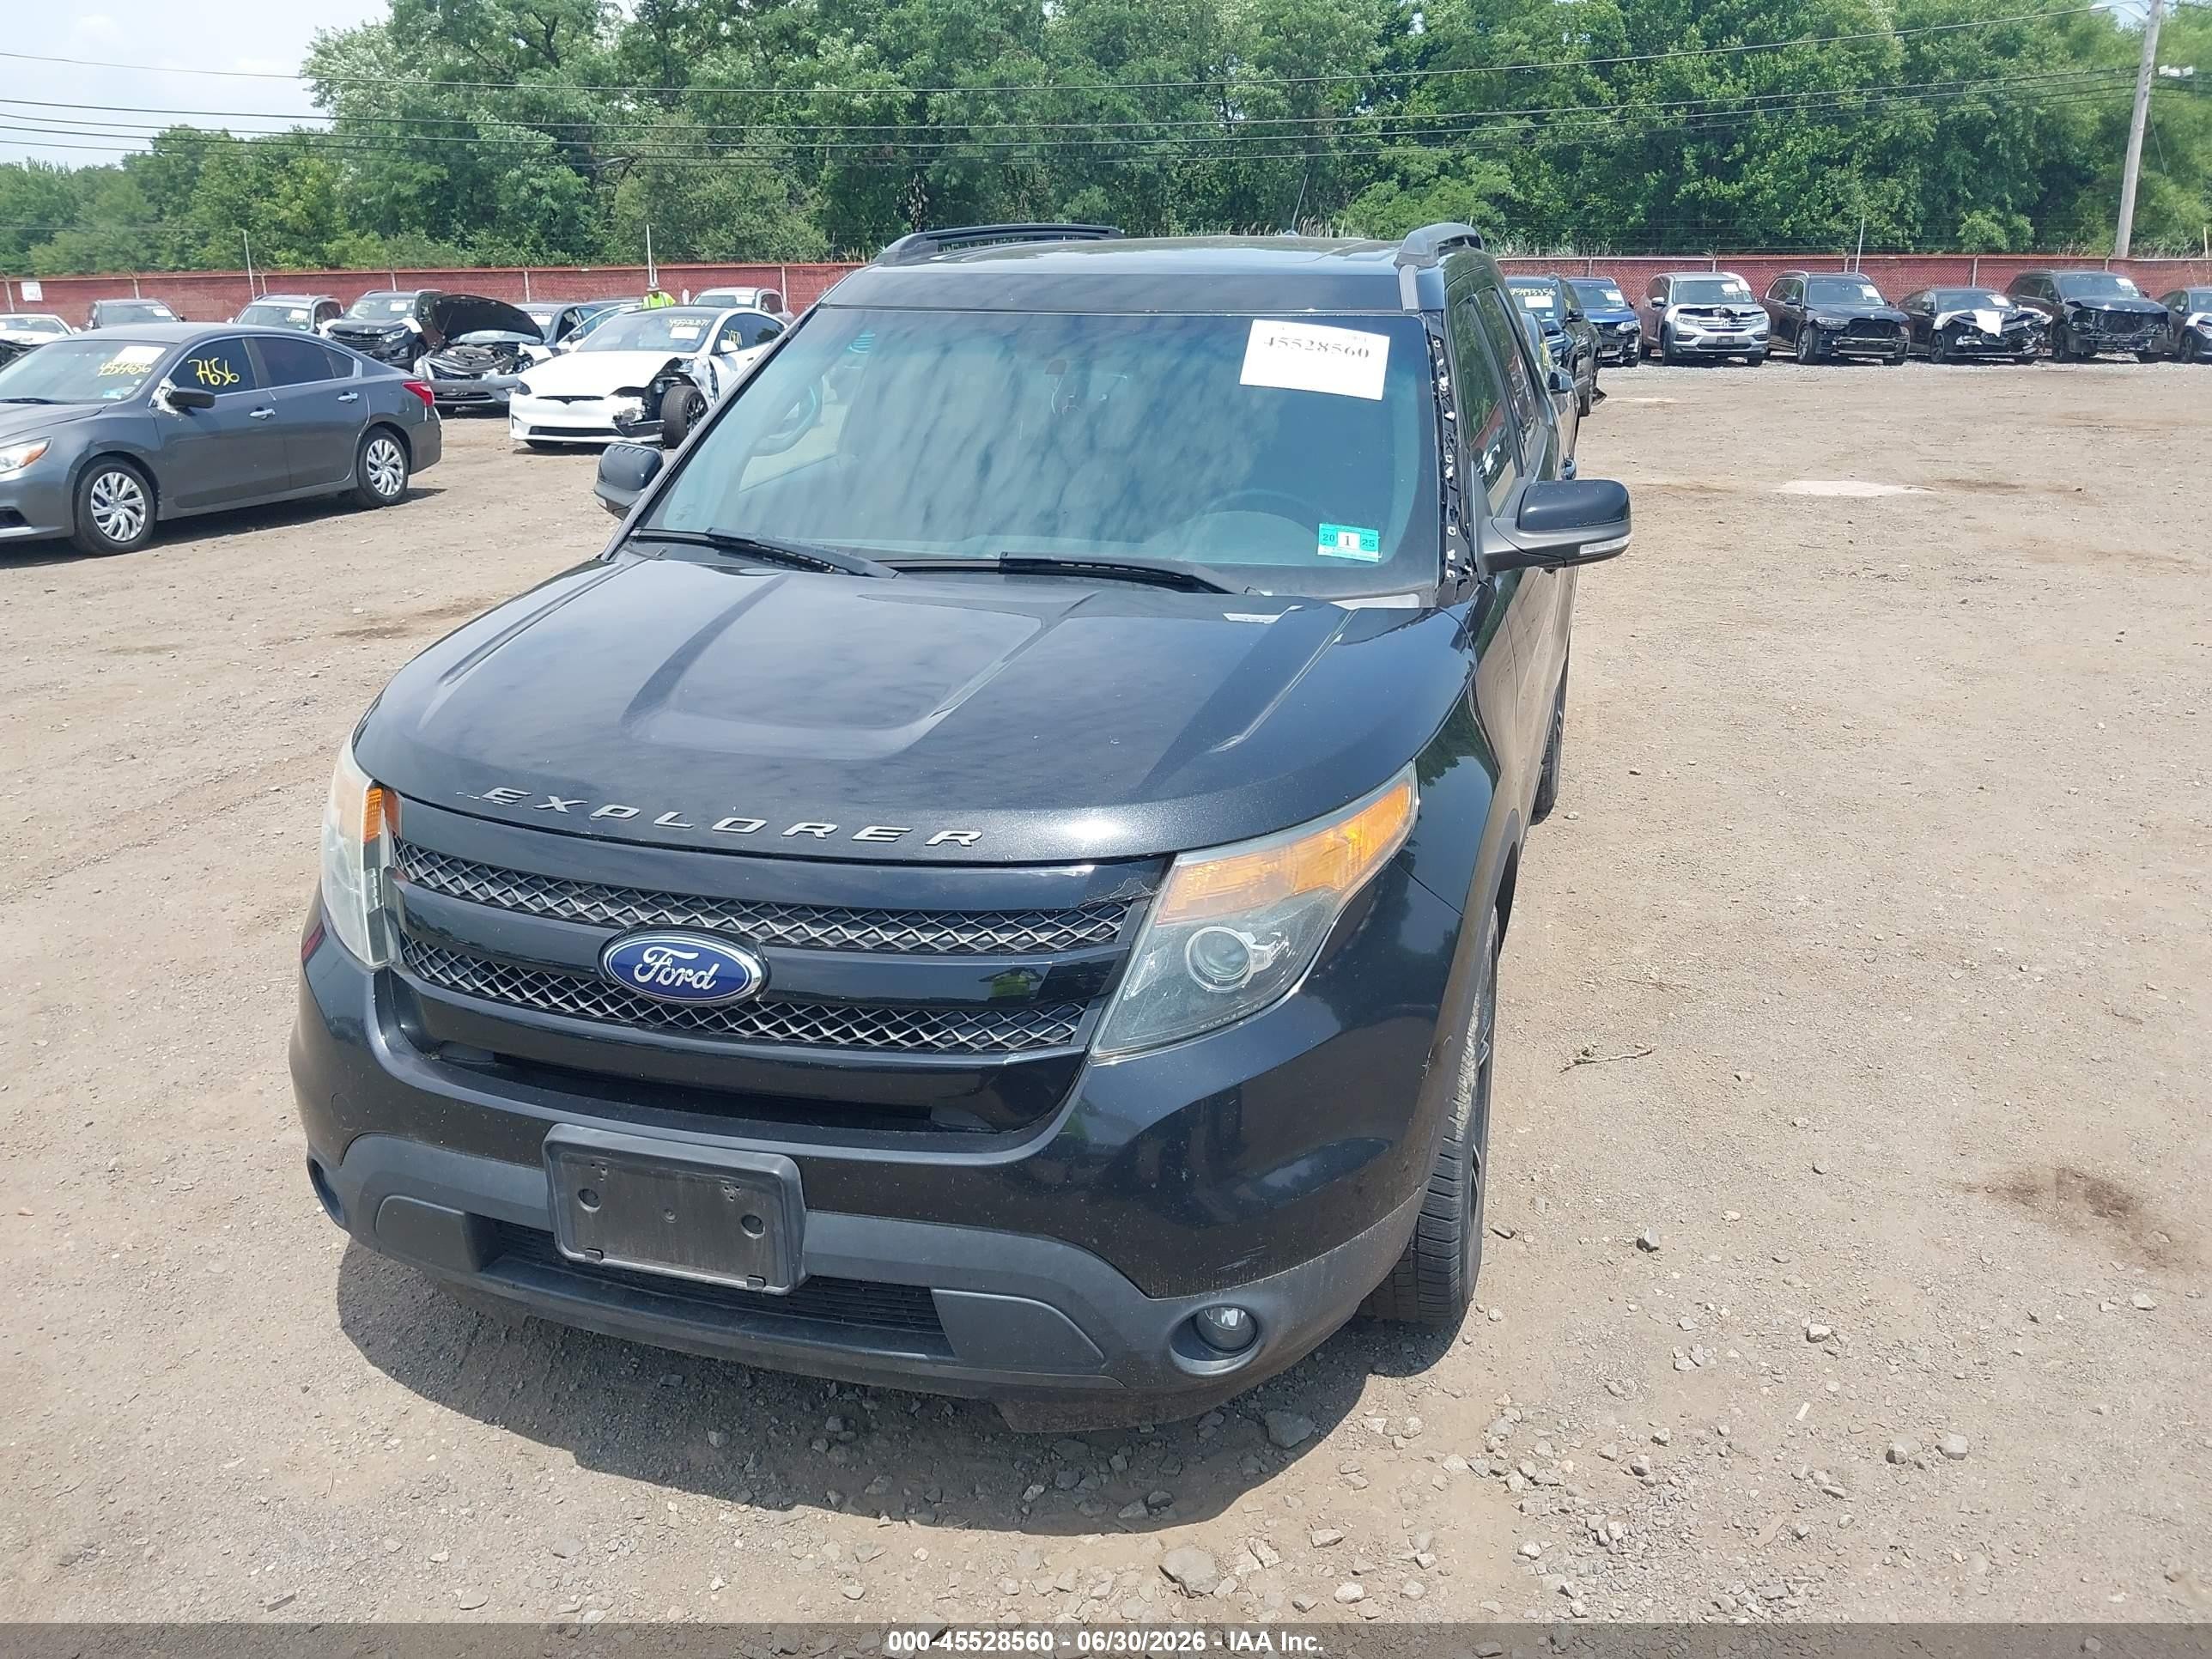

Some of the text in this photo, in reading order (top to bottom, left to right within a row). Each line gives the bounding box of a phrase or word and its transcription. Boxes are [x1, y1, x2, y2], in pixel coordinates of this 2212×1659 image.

[1264, 337, 1370, 358] 45528560
[1322, 532, 1375, 548] 20 1 25
[481, 787, 984, 848] EXPLORER
[633, 945, 718, 992] Ford
